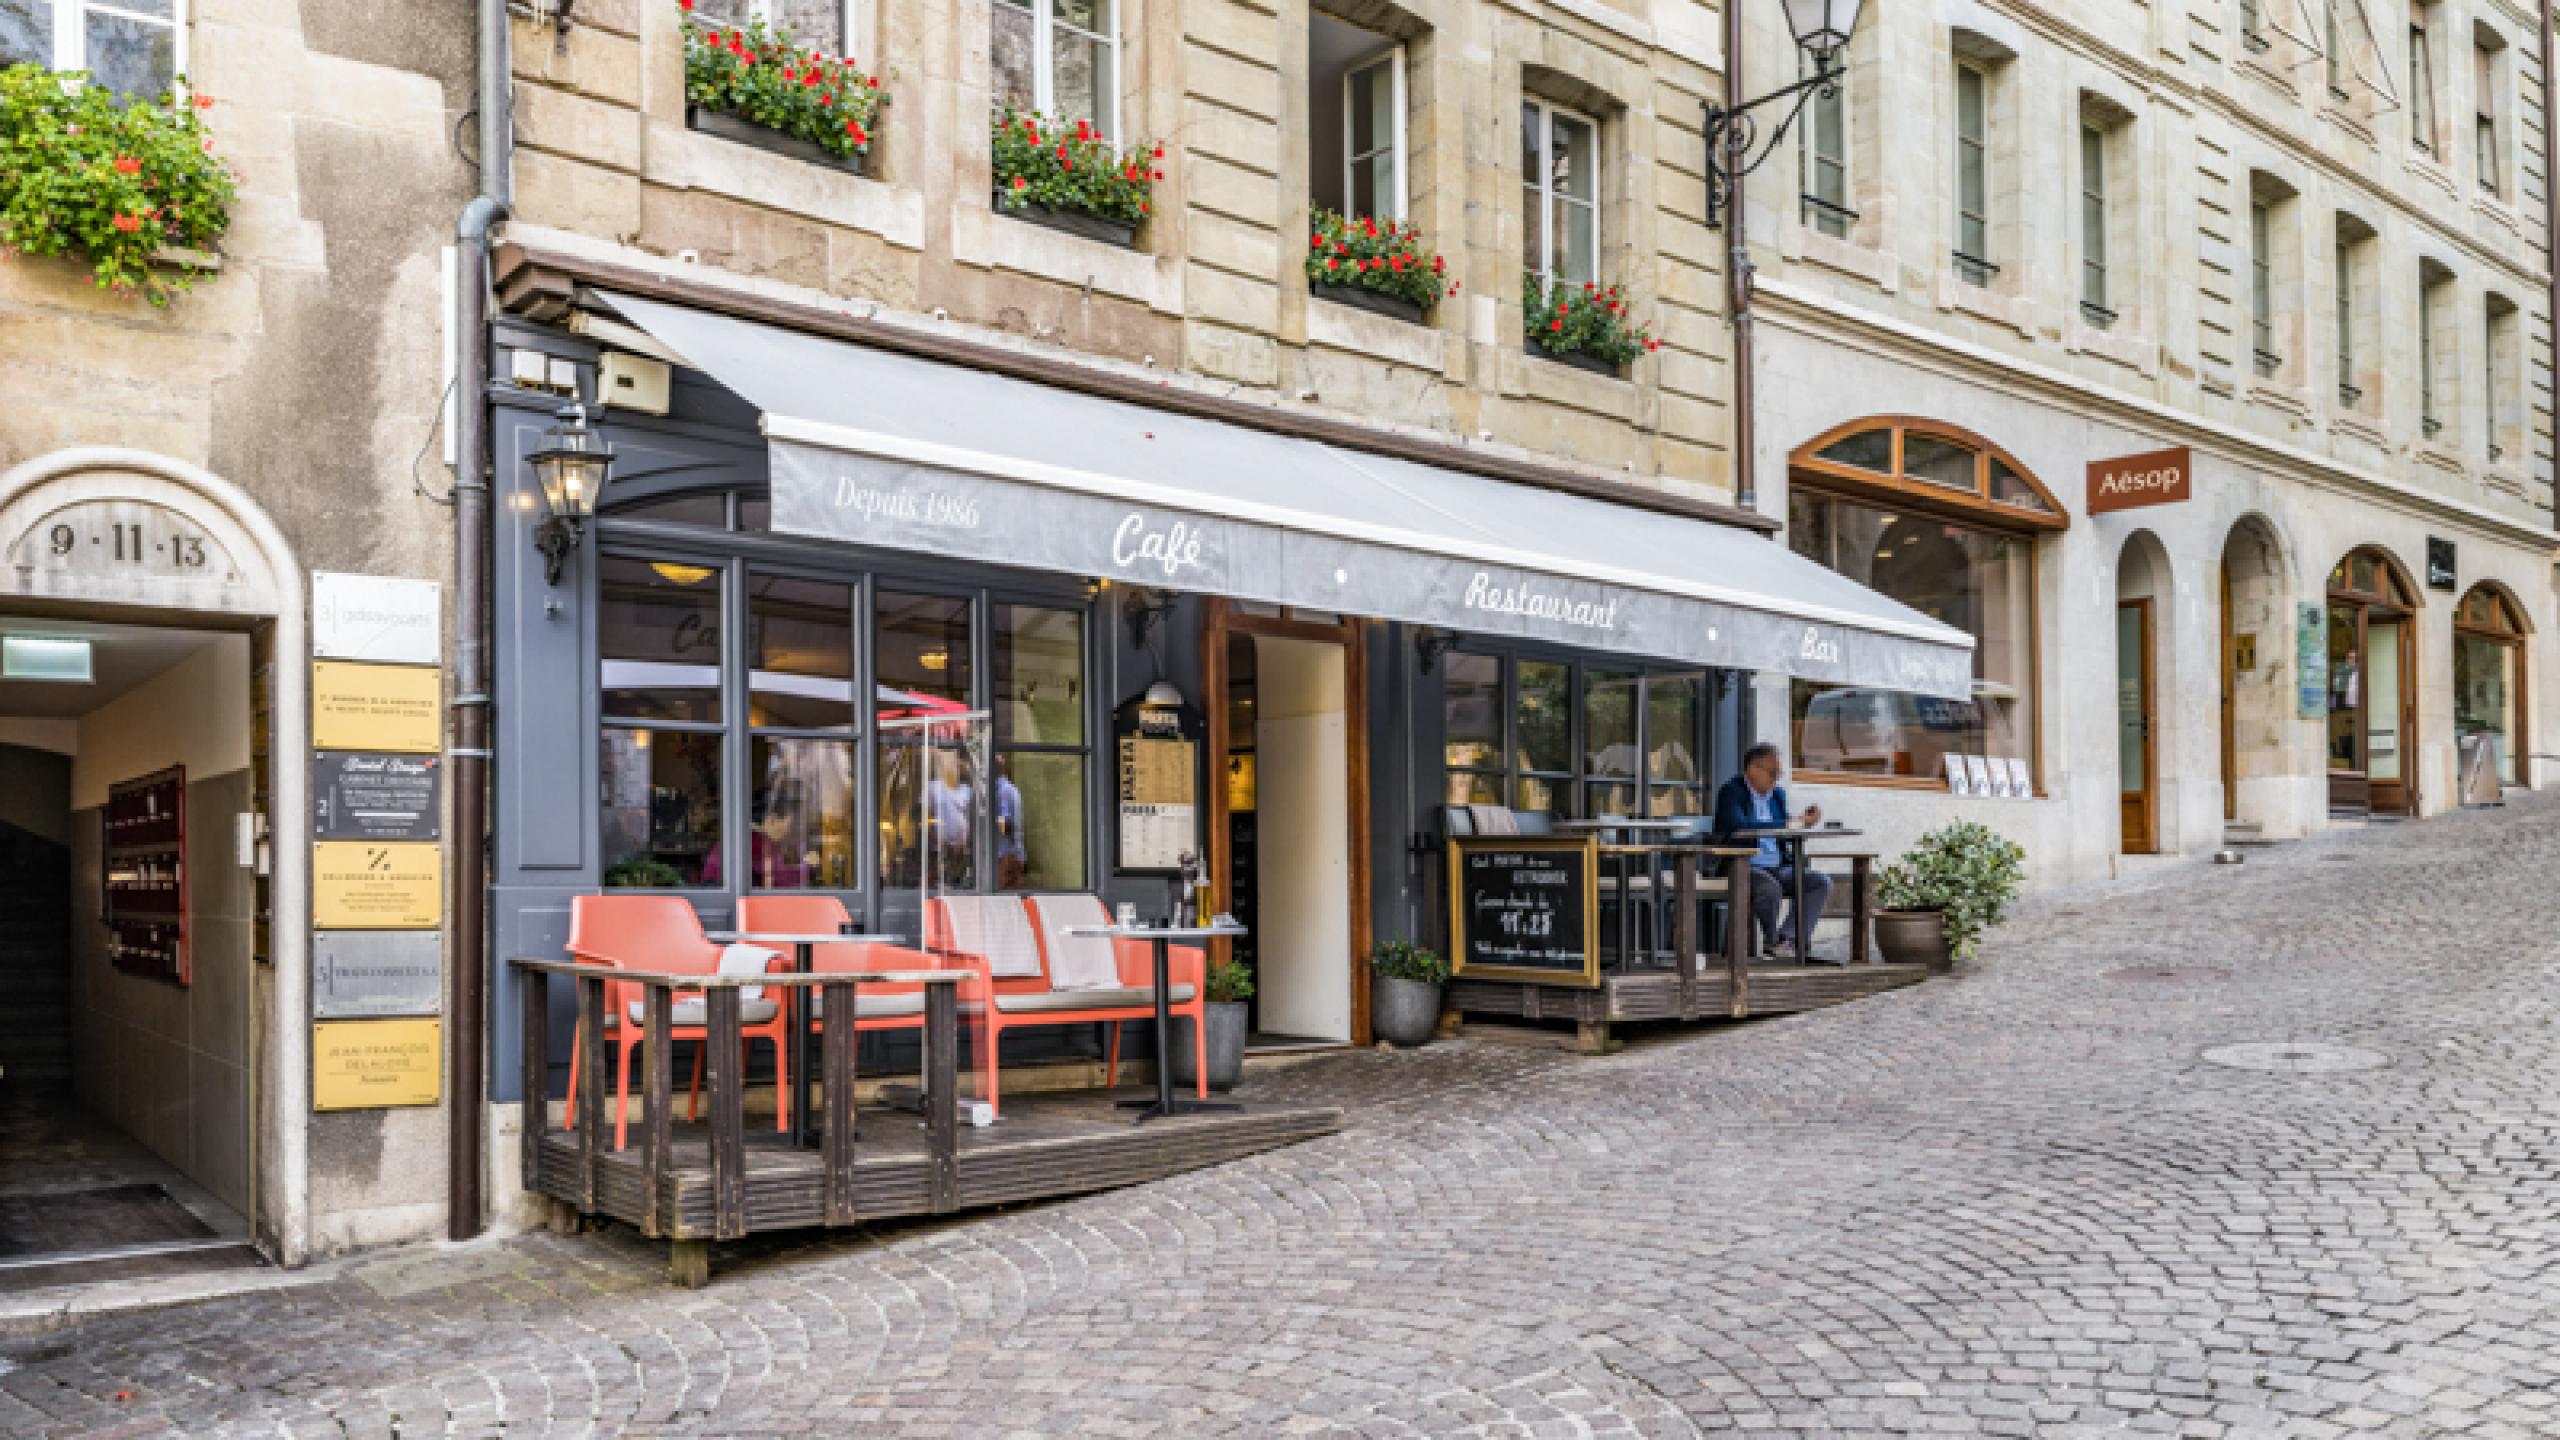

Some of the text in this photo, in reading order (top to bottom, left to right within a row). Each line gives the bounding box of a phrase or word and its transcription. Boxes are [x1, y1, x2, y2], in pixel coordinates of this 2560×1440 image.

[834, 476, 980, 529] Depuis 1986
[1112, 511, 1200, 576] Café
[1464, 572, 1617, 631] Restaurant
[1800, 626, 1838, 664] Bar
